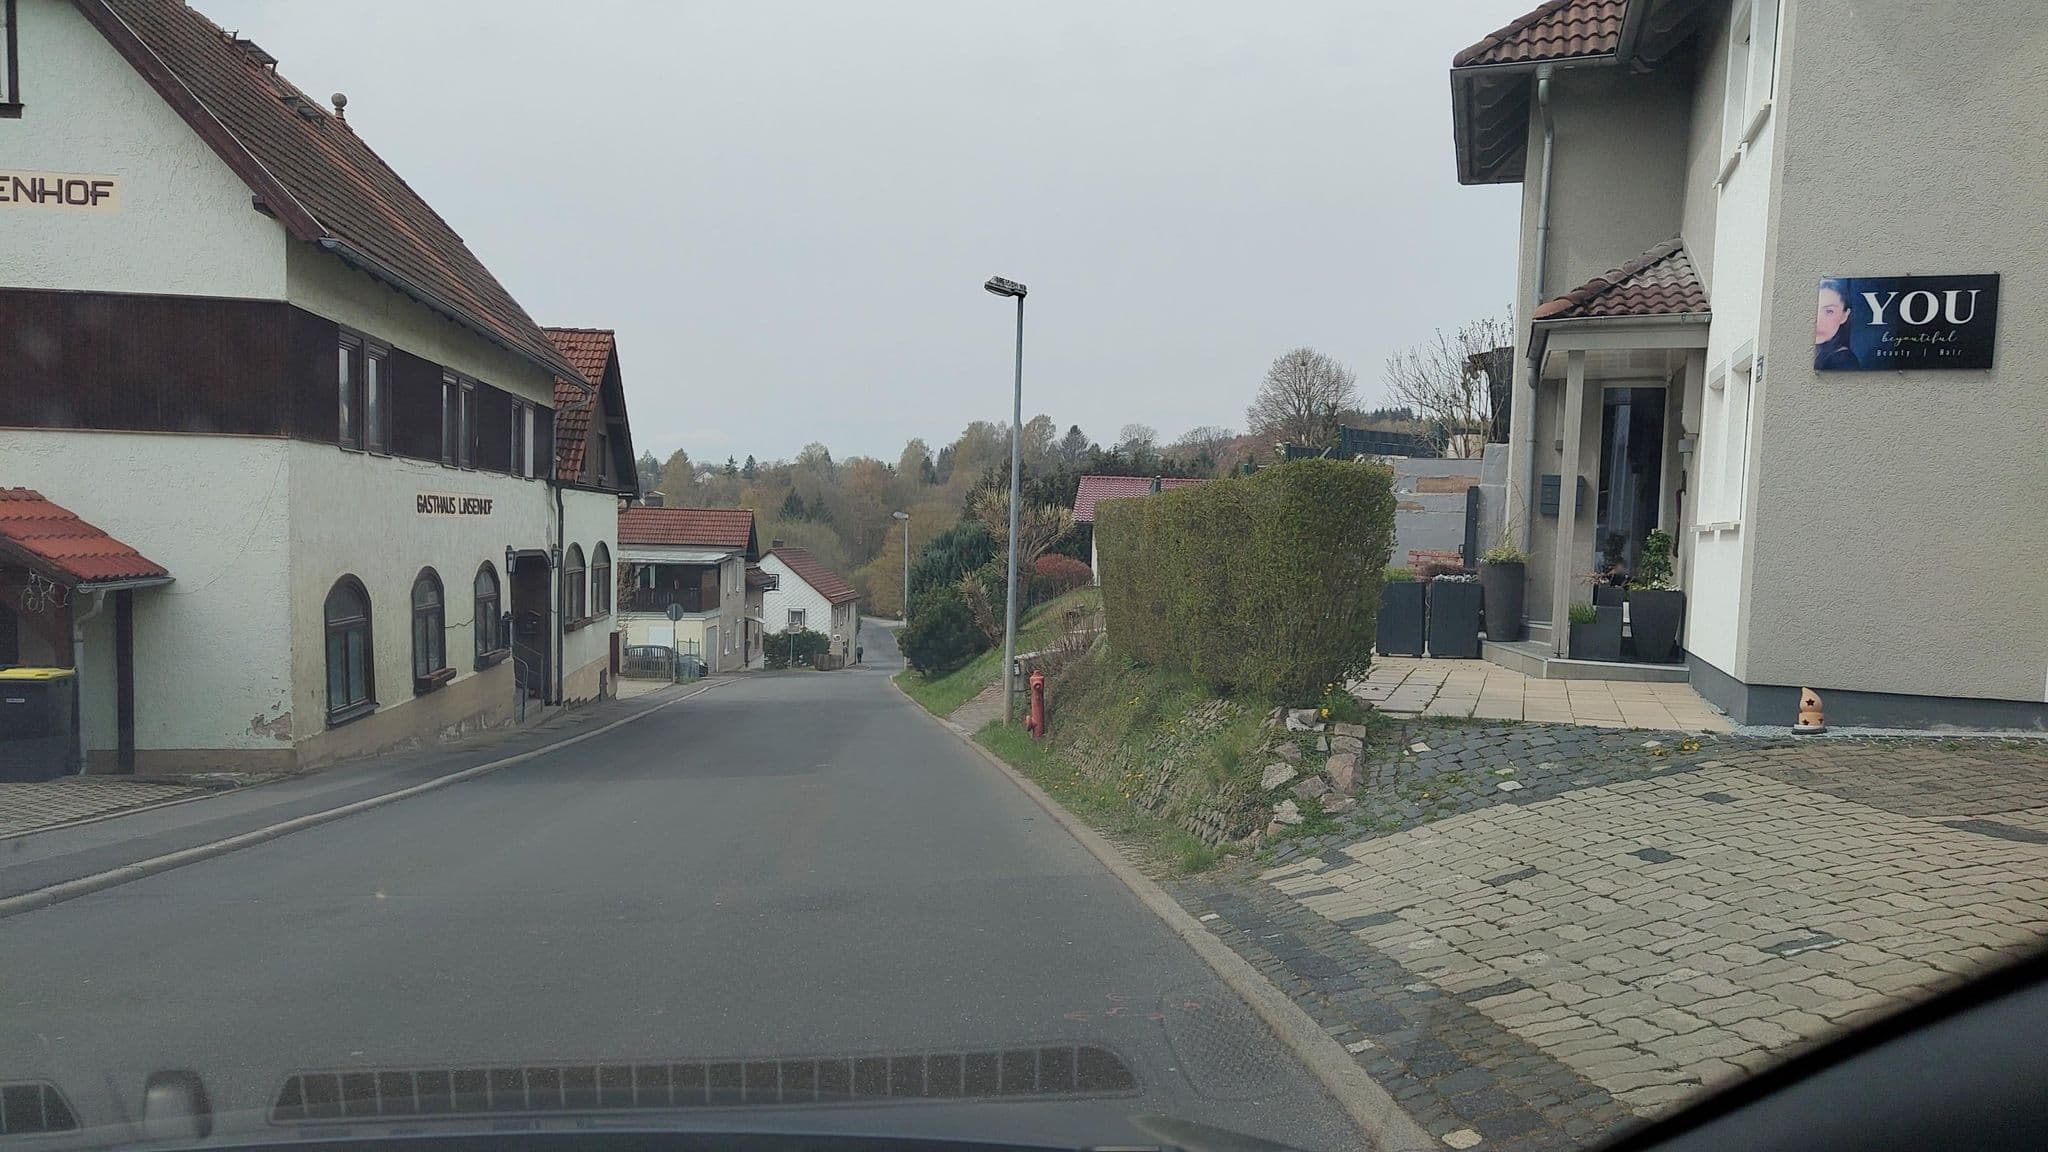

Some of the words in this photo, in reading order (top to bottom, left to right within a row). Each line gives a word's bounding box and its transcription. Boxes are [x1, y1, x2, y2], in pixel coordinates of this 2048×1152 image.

[1860, 289, 1982, 326] YOU
[1876, 349, 1911, 358] Beauty
[1939, 348, 1963, 357] Hair
[416, 494, 456, 515] GASTHAUS
